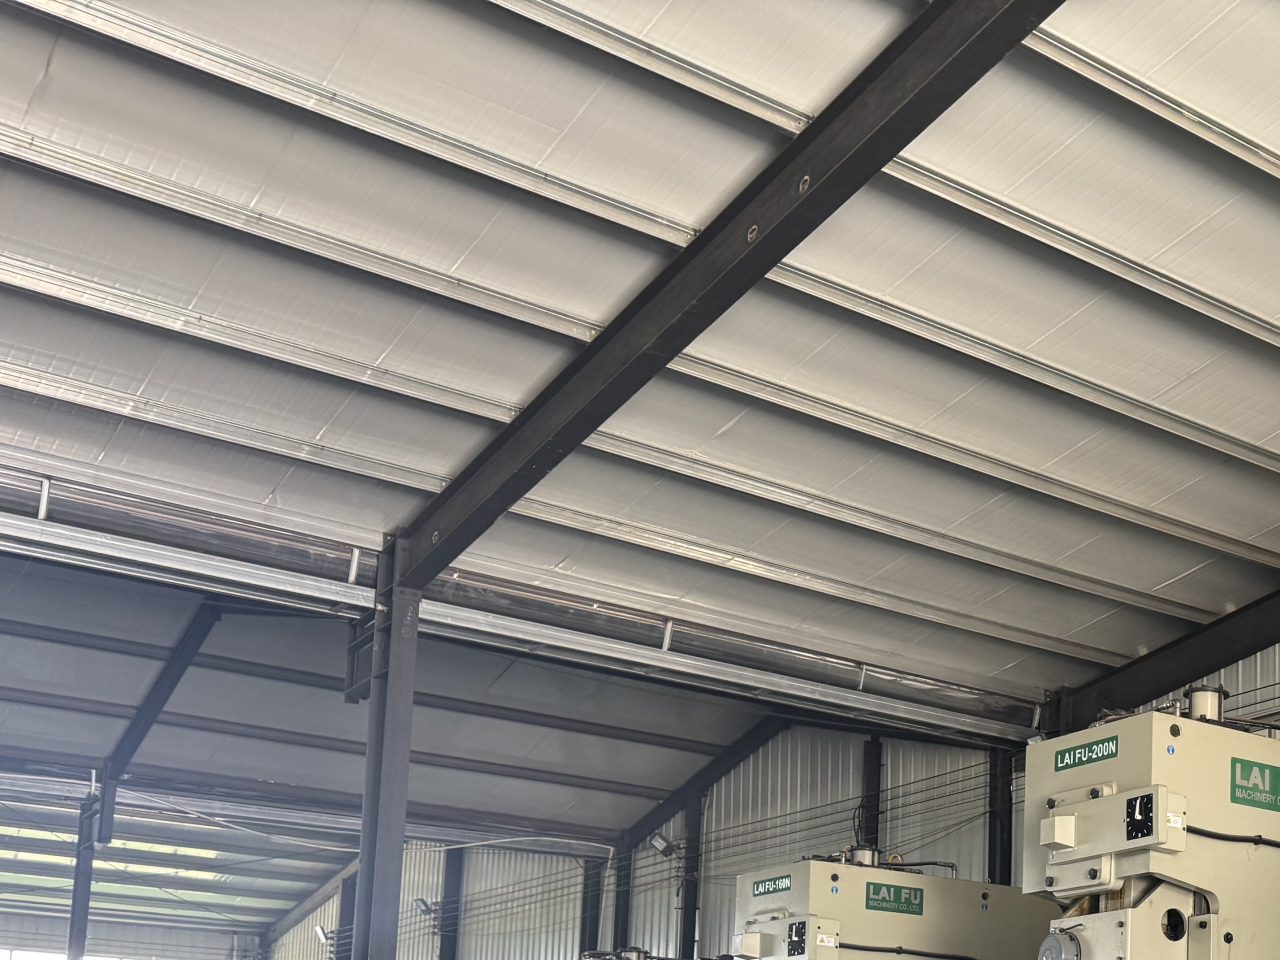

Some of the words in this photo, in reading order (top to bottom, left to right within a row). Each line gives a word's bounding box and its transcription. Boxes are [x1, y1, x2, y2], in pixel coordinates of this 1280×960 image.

[1057, 751, 1074, 768] LAI
[1075, 739, 1117, 763] FU-200N
[1235, 763, 1270, 791] LAI
[1235, 788, 1276, 806] MACHINERY
[754, 880, 765, 894] LAI
[765, 876, 791, 892] FU-160N
[869, 885, 894, 902] LAI
[901, 889, 921, 904] FU
